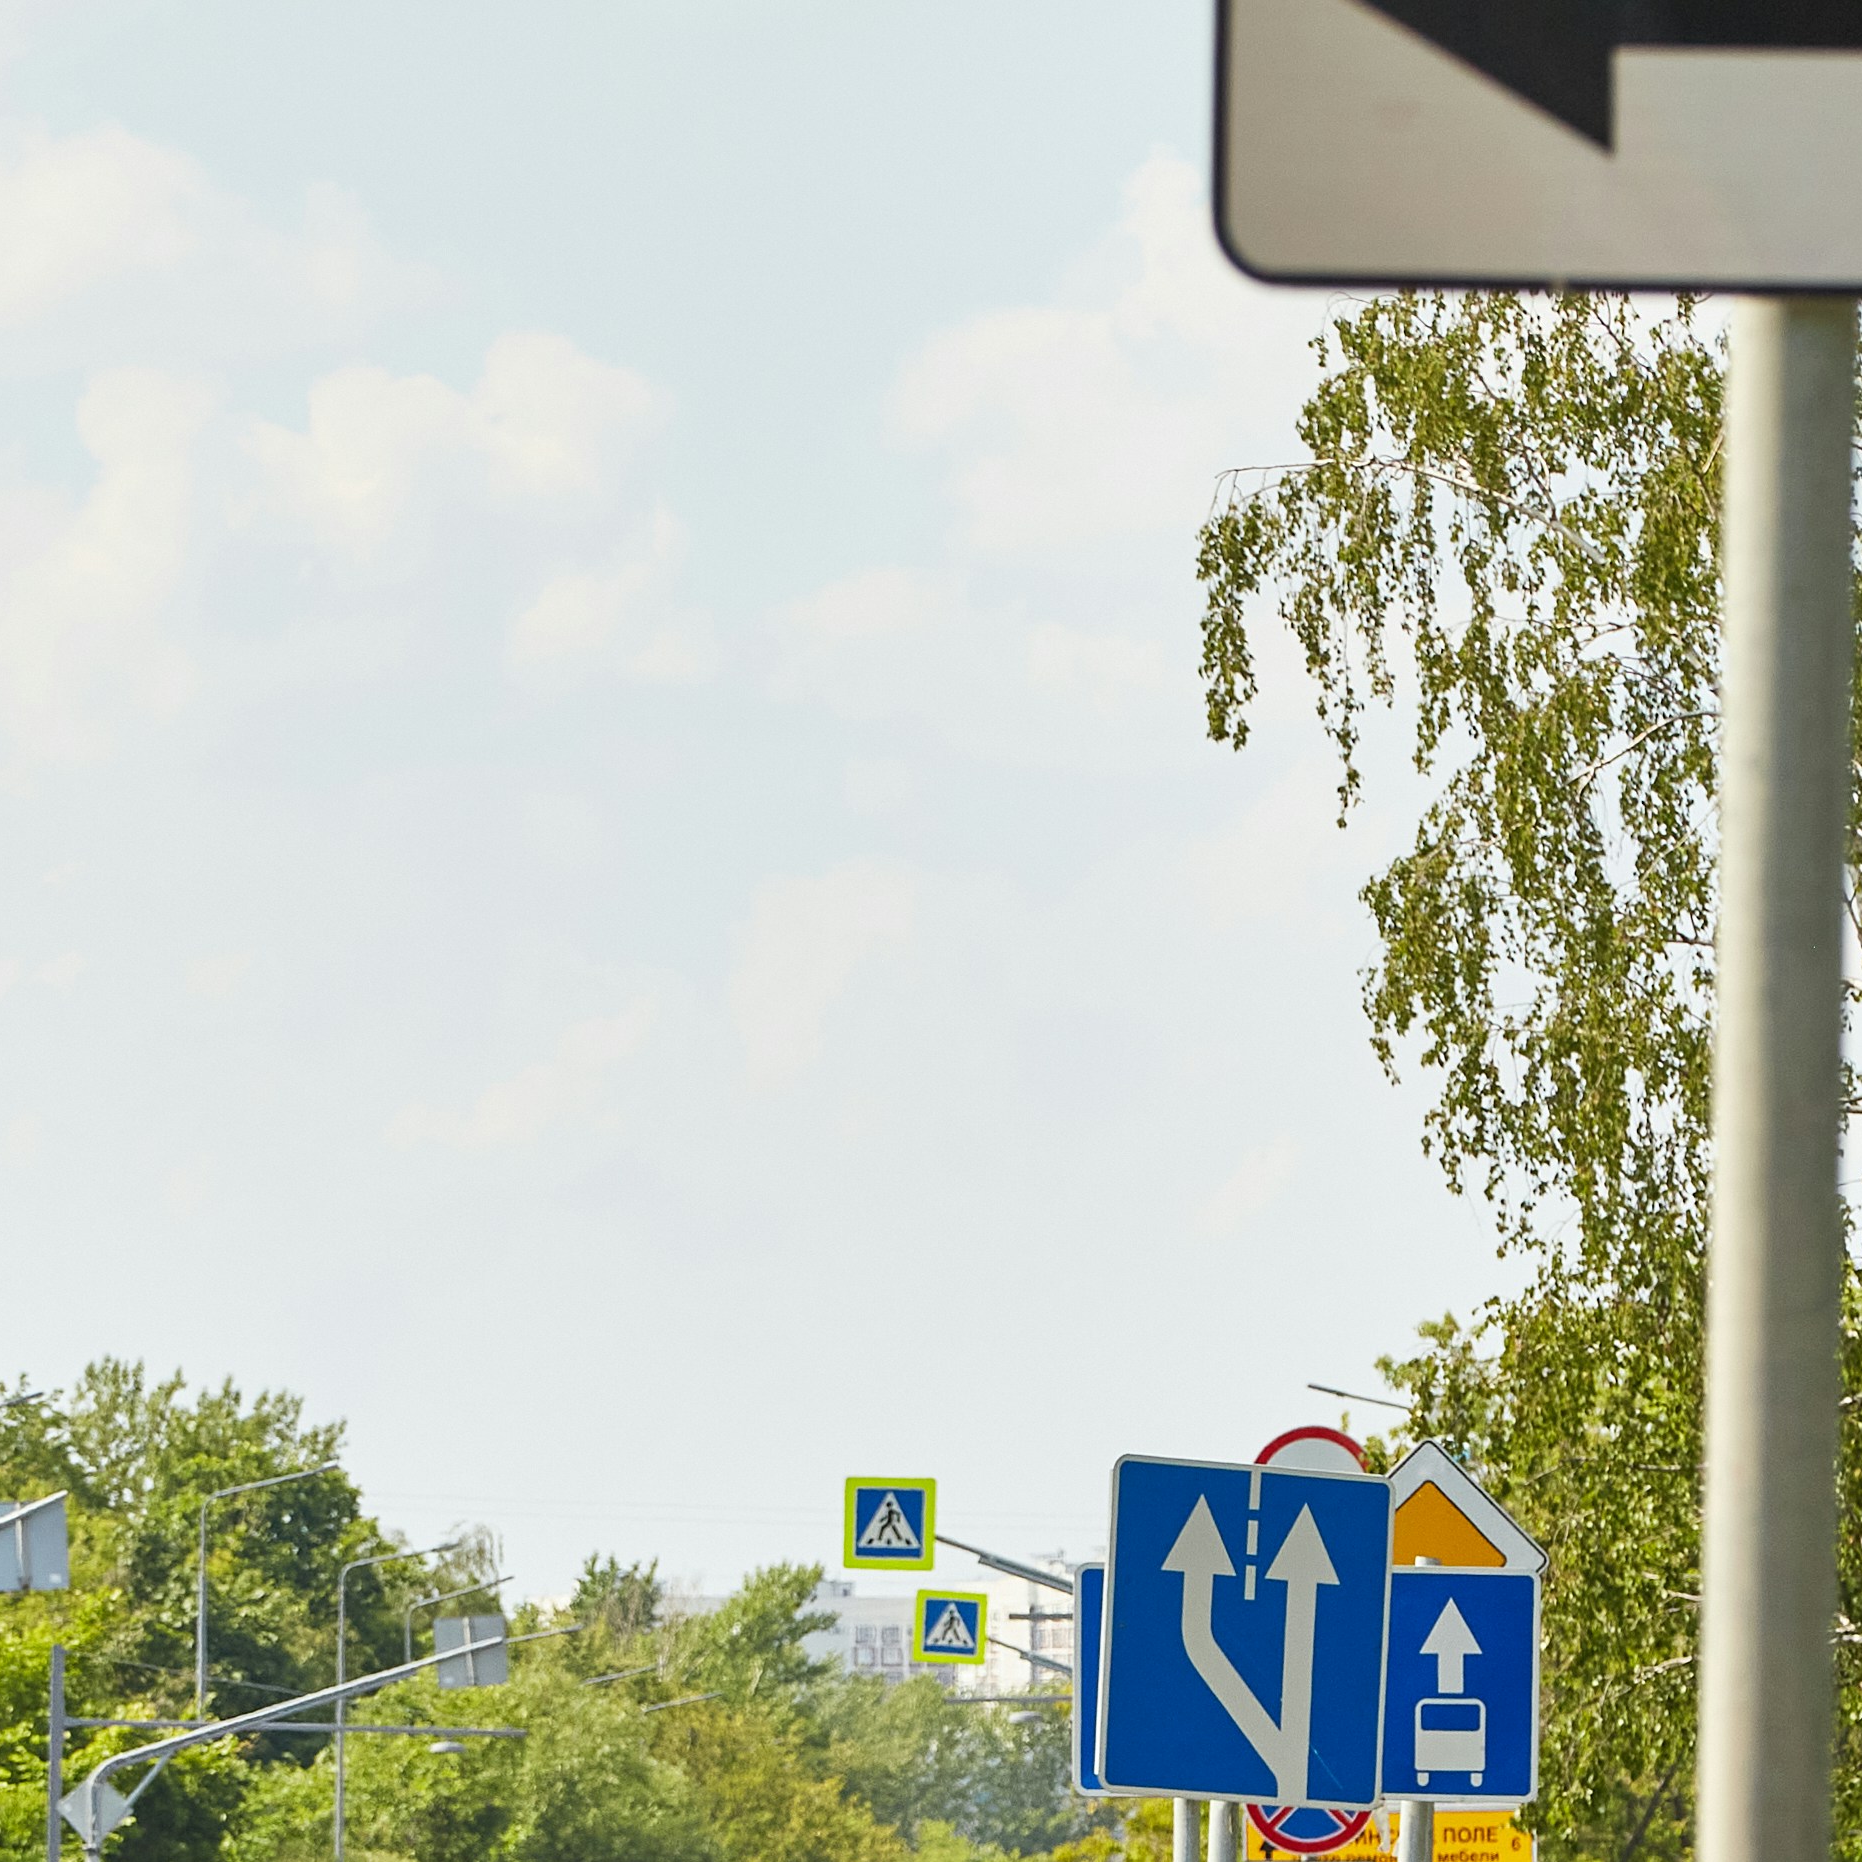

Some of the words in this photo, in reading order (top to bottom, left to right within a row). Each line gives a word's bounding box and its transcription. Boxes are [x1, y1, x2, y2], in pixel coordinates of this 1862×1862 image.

[1443, 1826, 1498, 1843] ПОЛЕ
[1511, 1837, 1522, 1852] 6
[1438, 1850, 1499, 1862] мебели
